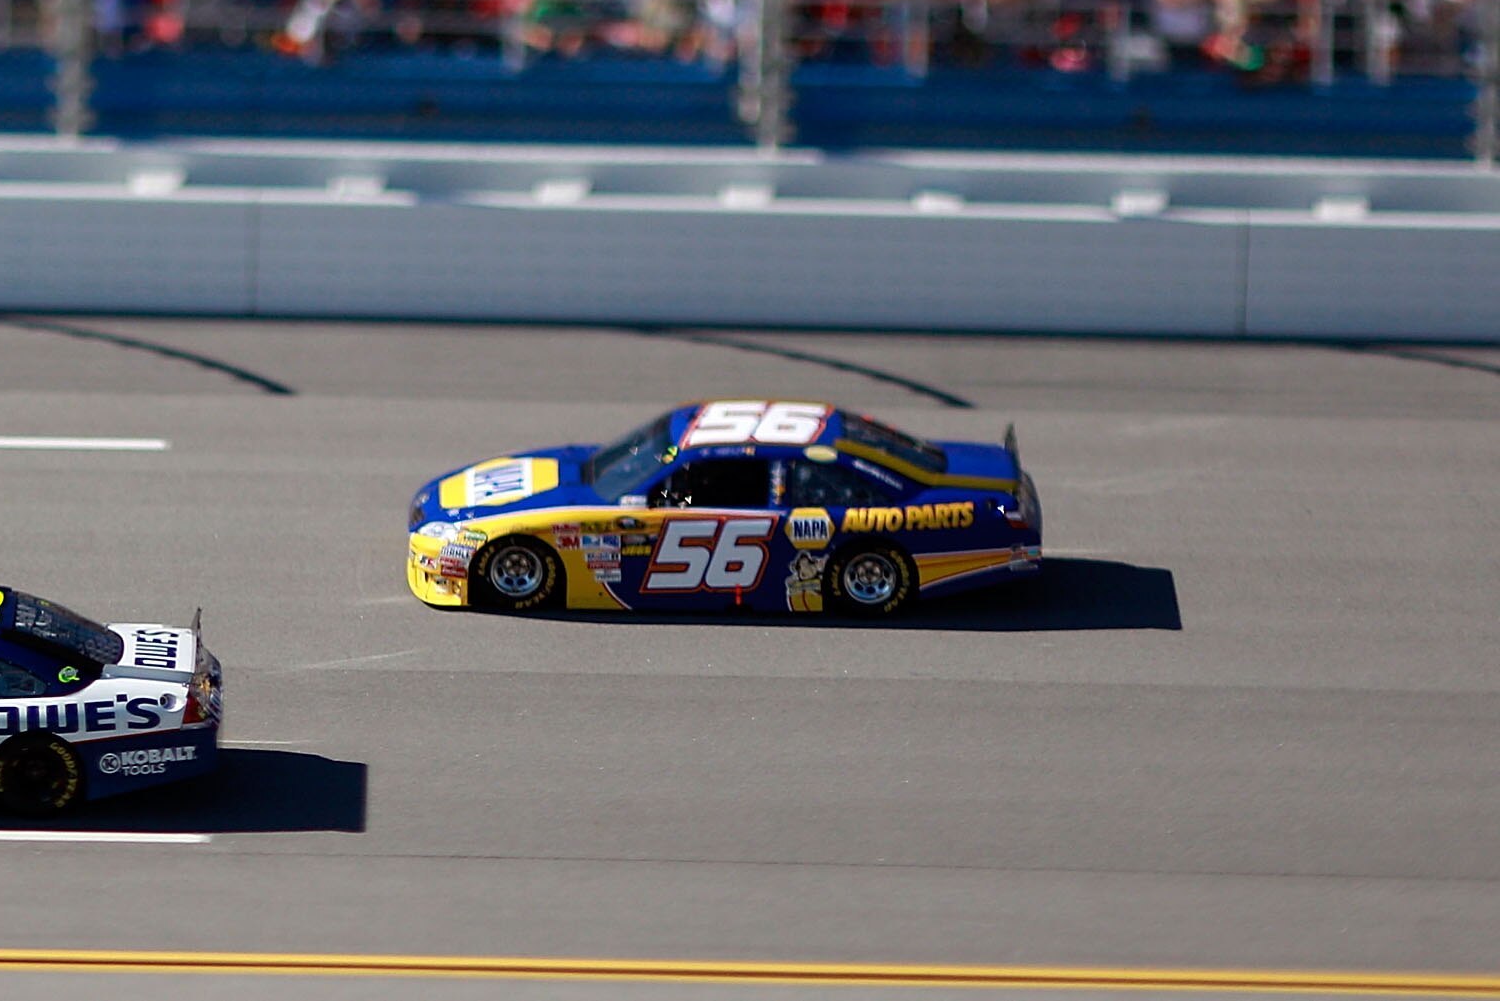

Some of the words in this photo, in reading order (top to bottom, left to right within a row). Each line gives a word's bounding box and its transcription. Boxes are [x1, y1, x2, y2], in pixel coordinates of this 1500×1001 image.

[683, 400, 834, 448] 56
[793, 519, 829, 539] NAPA
[841, 507, 903, 533] AUTO
[904, 501, 974, 531] PARTS
[641, 516, 778, 593] 56
[121, 746, 196, 766] KOBALT
[121, 763, 166, 777] TOOLS
